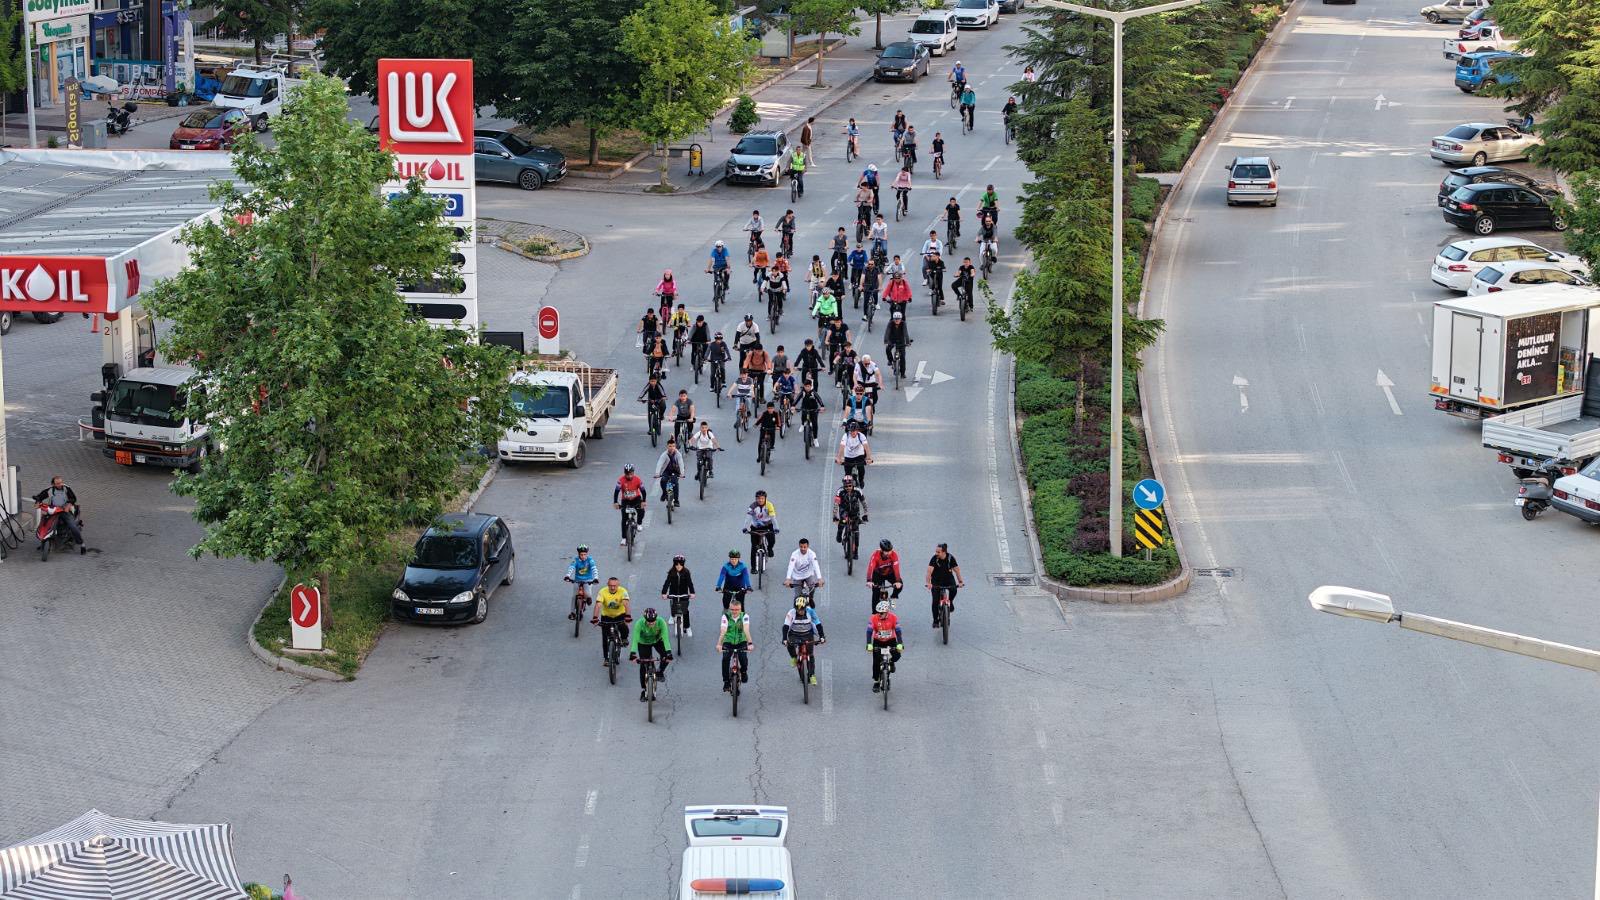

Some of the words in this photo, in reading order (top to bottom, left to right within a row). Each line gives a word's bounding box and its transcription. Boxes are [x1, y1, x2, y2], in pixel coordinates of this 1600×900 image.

[387, 71, 464, 143] LUK
[397, 158, 465, 181] UKOIL
[104, 326, 110, 336] 2
[1518, 333, 1554, 347] MUTLULUK
